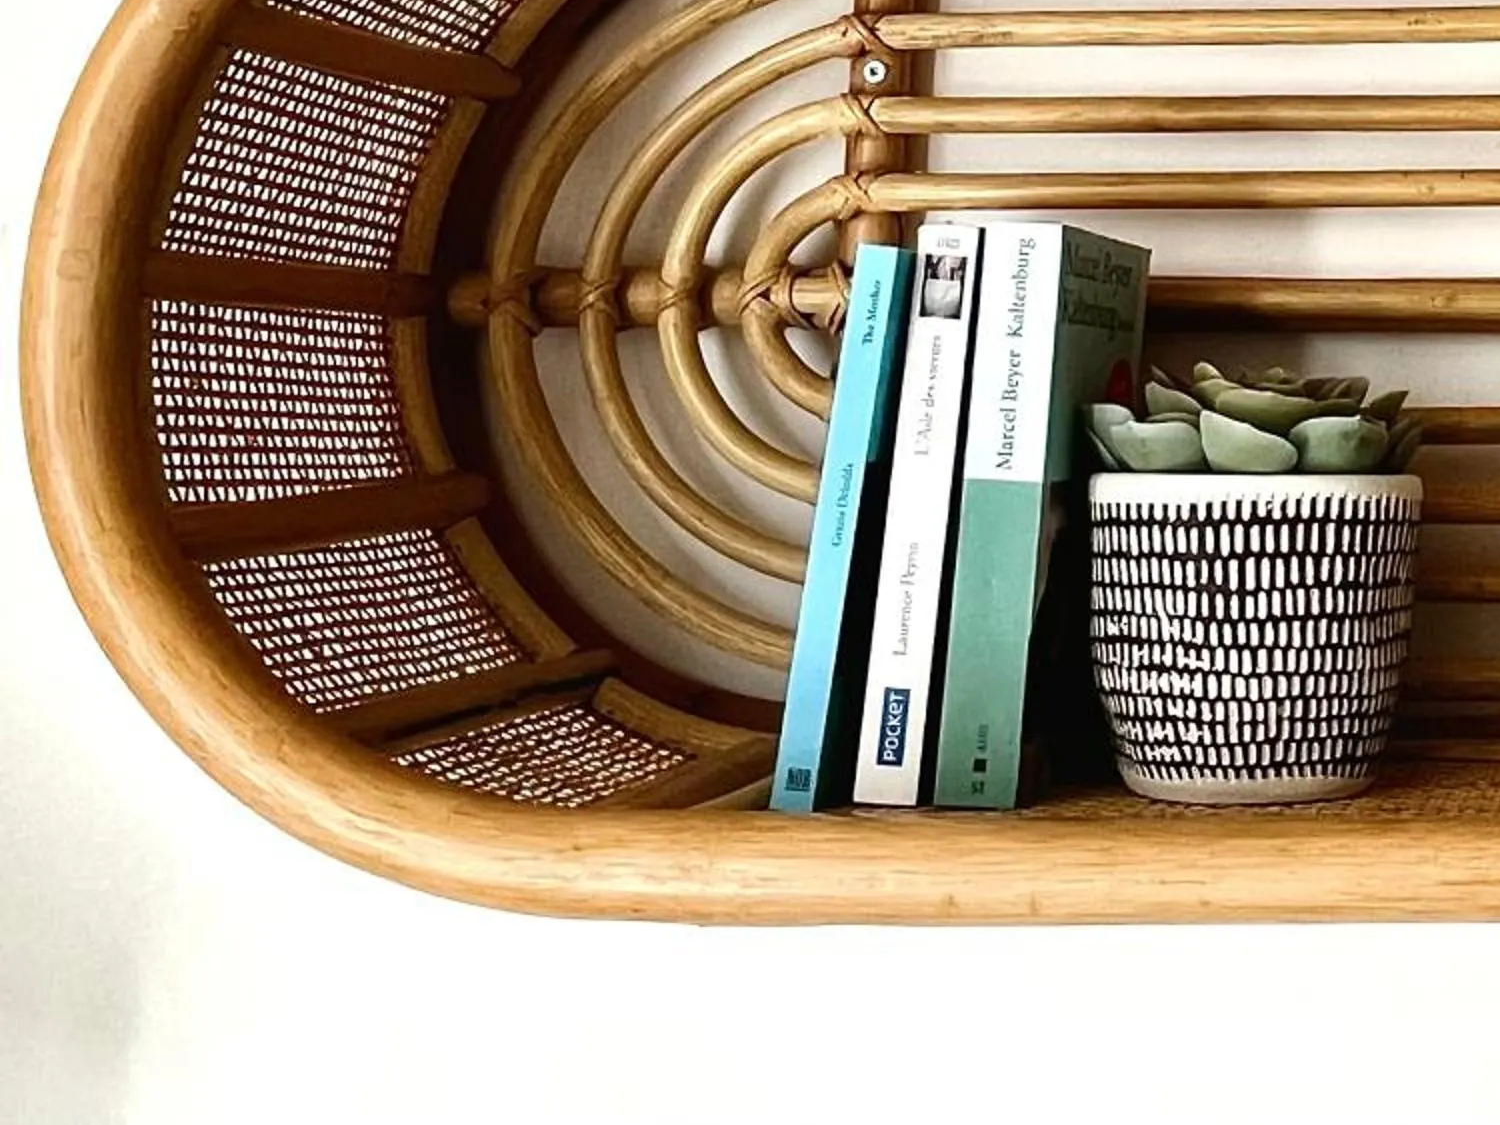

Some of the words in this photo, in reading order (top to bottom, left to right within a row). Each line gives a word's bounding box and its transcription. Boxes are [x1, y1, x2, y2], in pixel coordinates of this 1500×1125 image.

[1006, 236, 1037, 338] Kaltenburg
[862, 325, 874, 346] The
[1001, 348, 1025, 403] Beyer
[995, 407, 1018, 471] Marcel
[892, 589, 914, 656] Laurence
